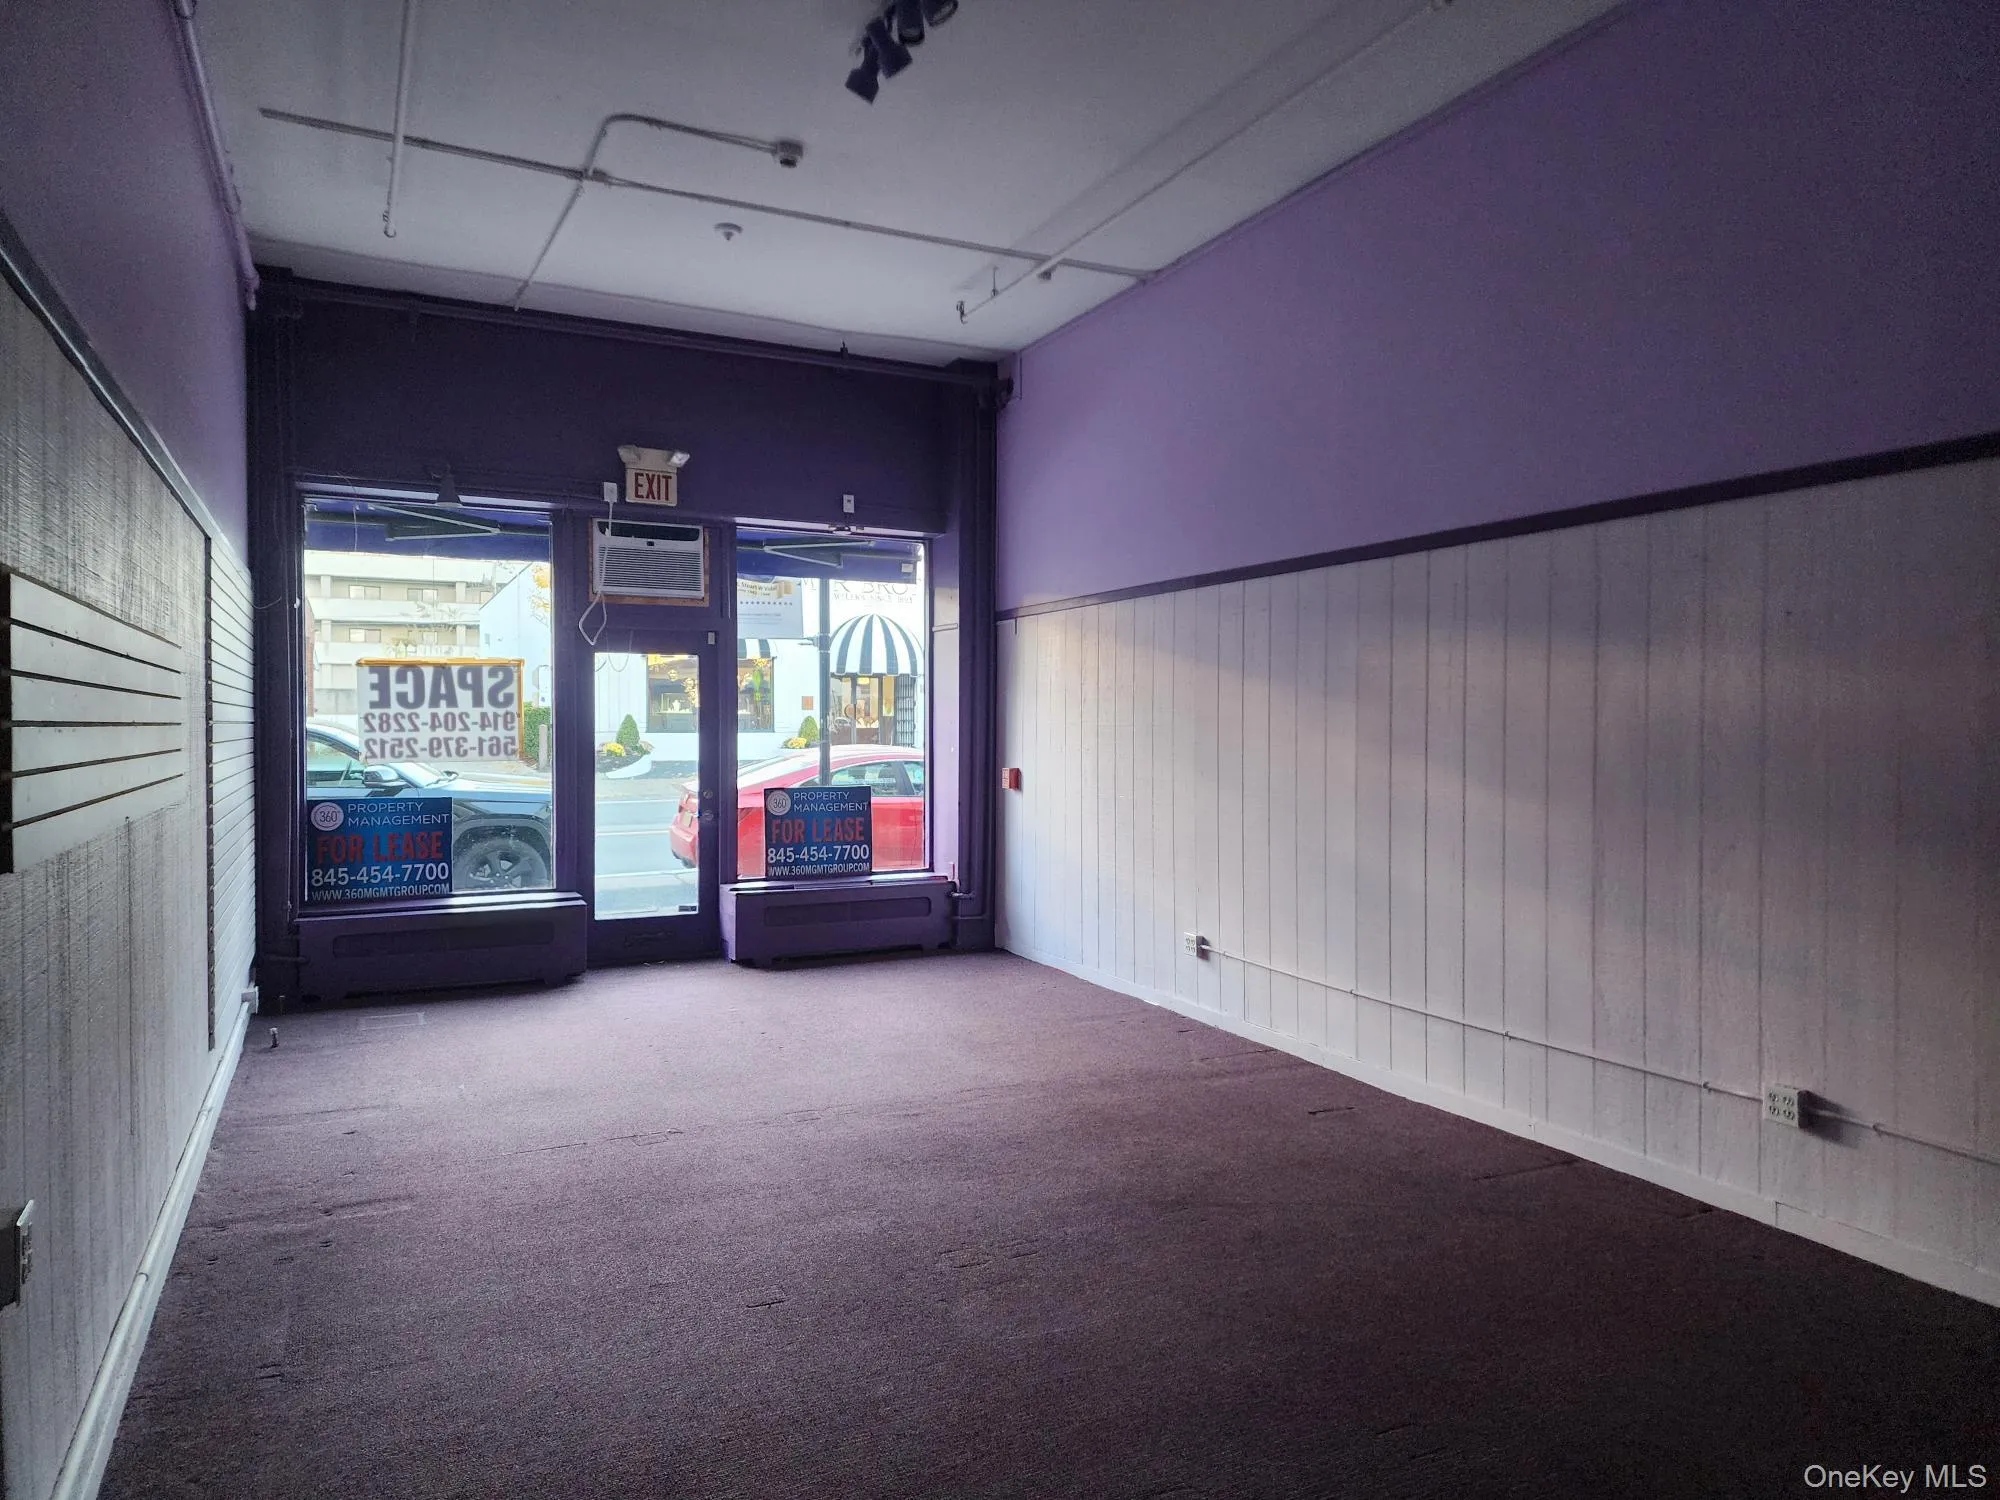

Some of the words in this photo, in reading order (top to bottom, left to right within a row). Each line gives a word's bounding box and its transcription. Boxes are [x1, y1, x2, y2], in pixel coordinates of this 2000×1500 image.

[633, 472, 673, 502] EXIT
[793, 791, 850, 801] PROPERTY
[347, 802, 425, 814] PROPERTY
[772, 798, 787, 809] 360
[793, 802, 869, 812] MANAGEMENT
[319, 810, 338, 823] 360
[347, 813, 450, 827] MANAGEMENT
[771, 818, 806, 844] FOR
[812, 816, 865, 843] LEASE
[317, 834, 365, 865] FOR
[373, 831, 444, 863] LEASE
[767, 844, 870, 864] 845-454-7700
[311, 862, 450, 887] 845-454-7700
